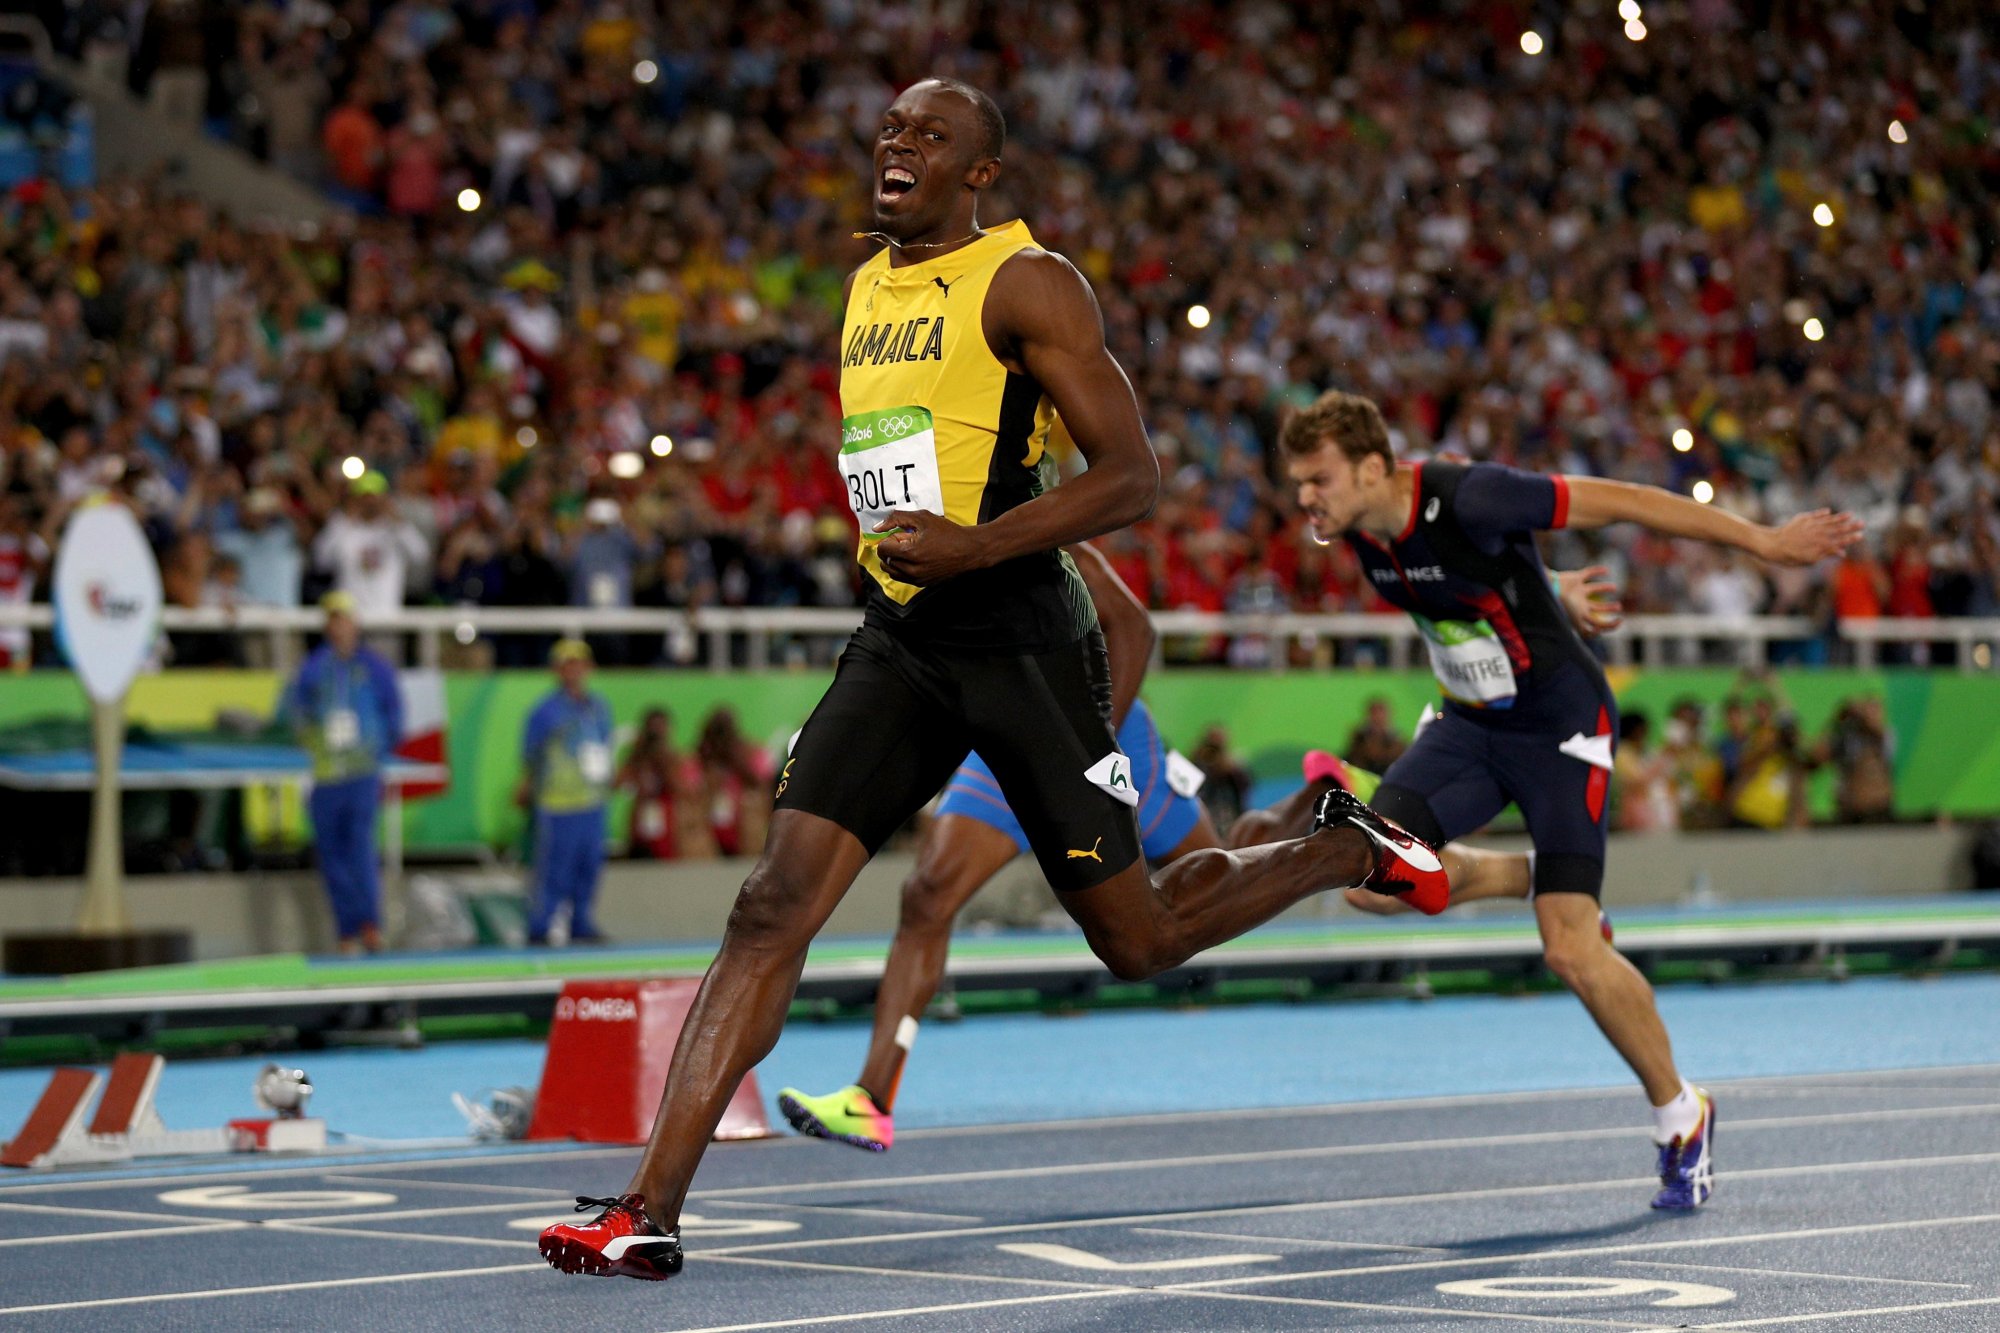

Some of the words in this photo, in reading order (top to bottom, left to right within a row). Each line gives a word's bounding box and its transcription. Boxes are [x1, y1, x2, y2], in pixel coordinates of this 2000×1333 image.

[842, 316, 944, 368] JAMAICA
[848, 463, 915, 512] BOLT
[1371, 565, 1446, 584] FRANCE
[576, 997, 637, 1021] OMEGA
